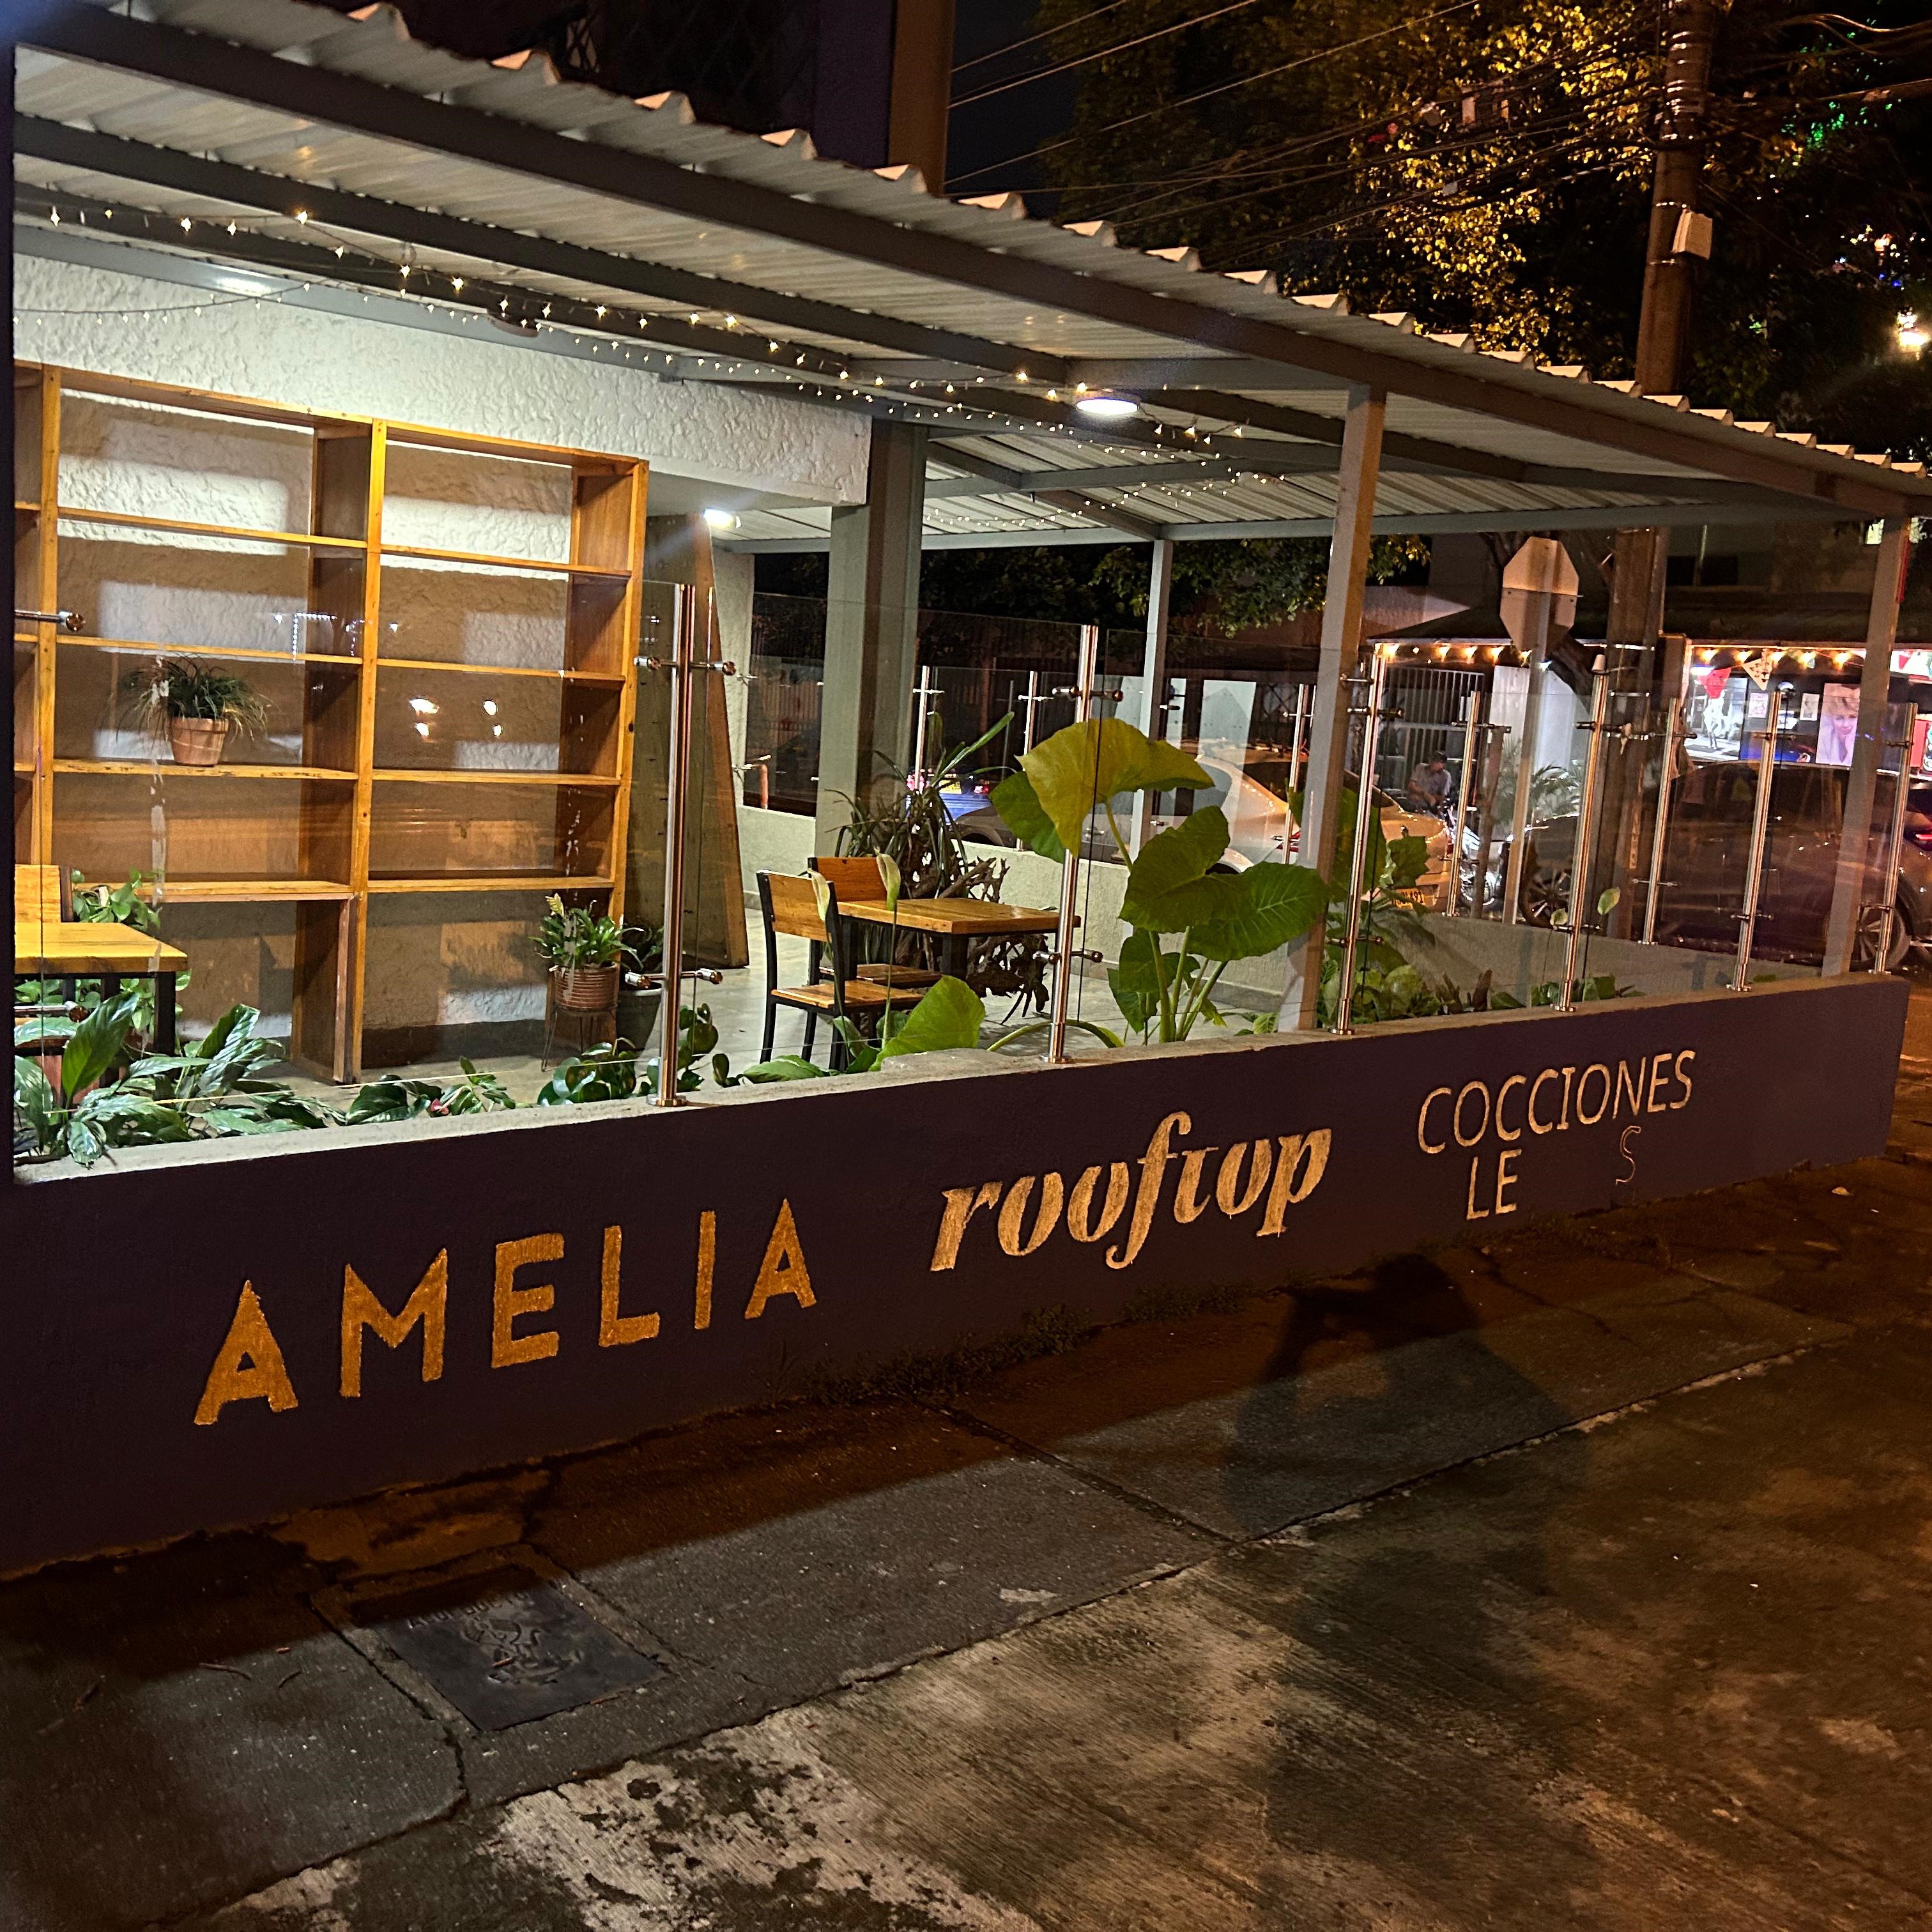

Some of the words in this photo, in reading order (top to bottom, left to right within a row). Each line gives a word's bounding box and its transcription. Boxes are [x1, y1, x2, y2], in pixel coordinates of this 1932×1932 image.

[1417, 1049, 1697, 1155] COCCIONES
[930, 1110, 1332, 1273] rooftop
[192, 1197, 818, 1427] AMELIA
